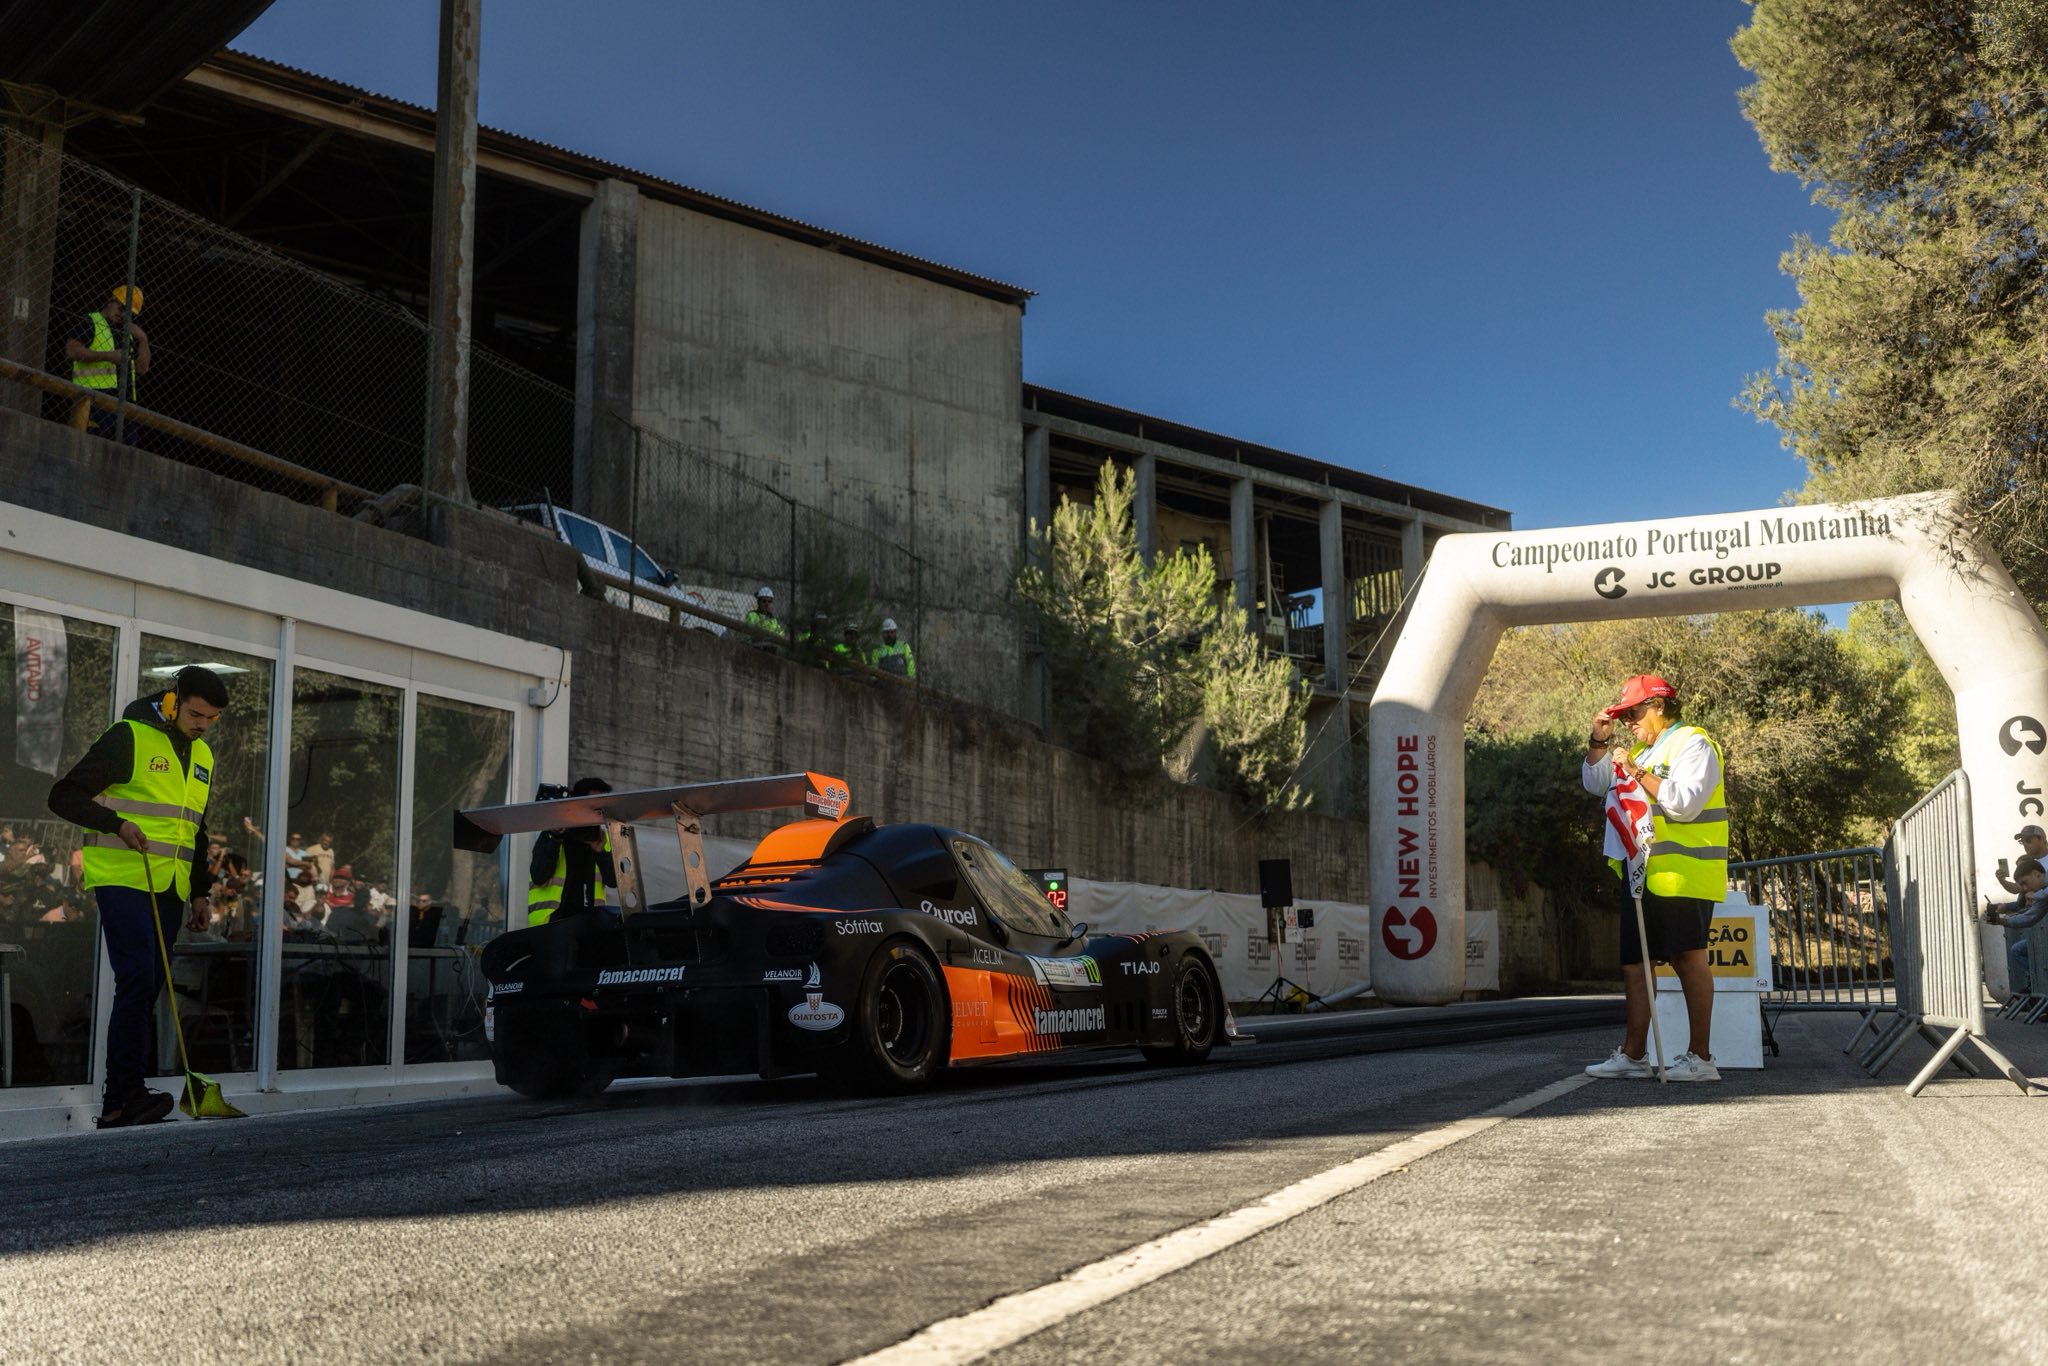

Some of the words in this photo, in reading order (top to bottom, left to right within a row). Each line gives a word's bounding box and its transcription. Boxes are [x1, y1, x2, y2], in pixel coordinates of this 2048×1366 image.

[1492, 536, 1638, 574] Campeonato
[1647, 521, 1751, 560] Portugal
[1760, 509, 1892, 547] Montanha
[1646, 571, 1676, 590] JC
[1689, 561, 1782, 586] GROUP
[1727, 580, 1784, 592] www.jcgroup.pt
[149, 763, 170, 772] CMS
[1397, 735, 1419, 816] HOPE
[1425, 735, 1438, 808] IMOBILIÁRIOS
[2016, 780, 2044, 817] JC
[1398, 827, 1420, 898] NEW
[1428, 811, 1438, 898] INVESTIMENTOS
[835, 919, 884, 936] Sófritar
[763, 969, 802, 980] VELANOIR
[1120, 961, 1160, 975] TIAJO
[793, 1012, 839, 1022] DIATOSTA
[1034, 1004, 1106, 1035] famaconcret
